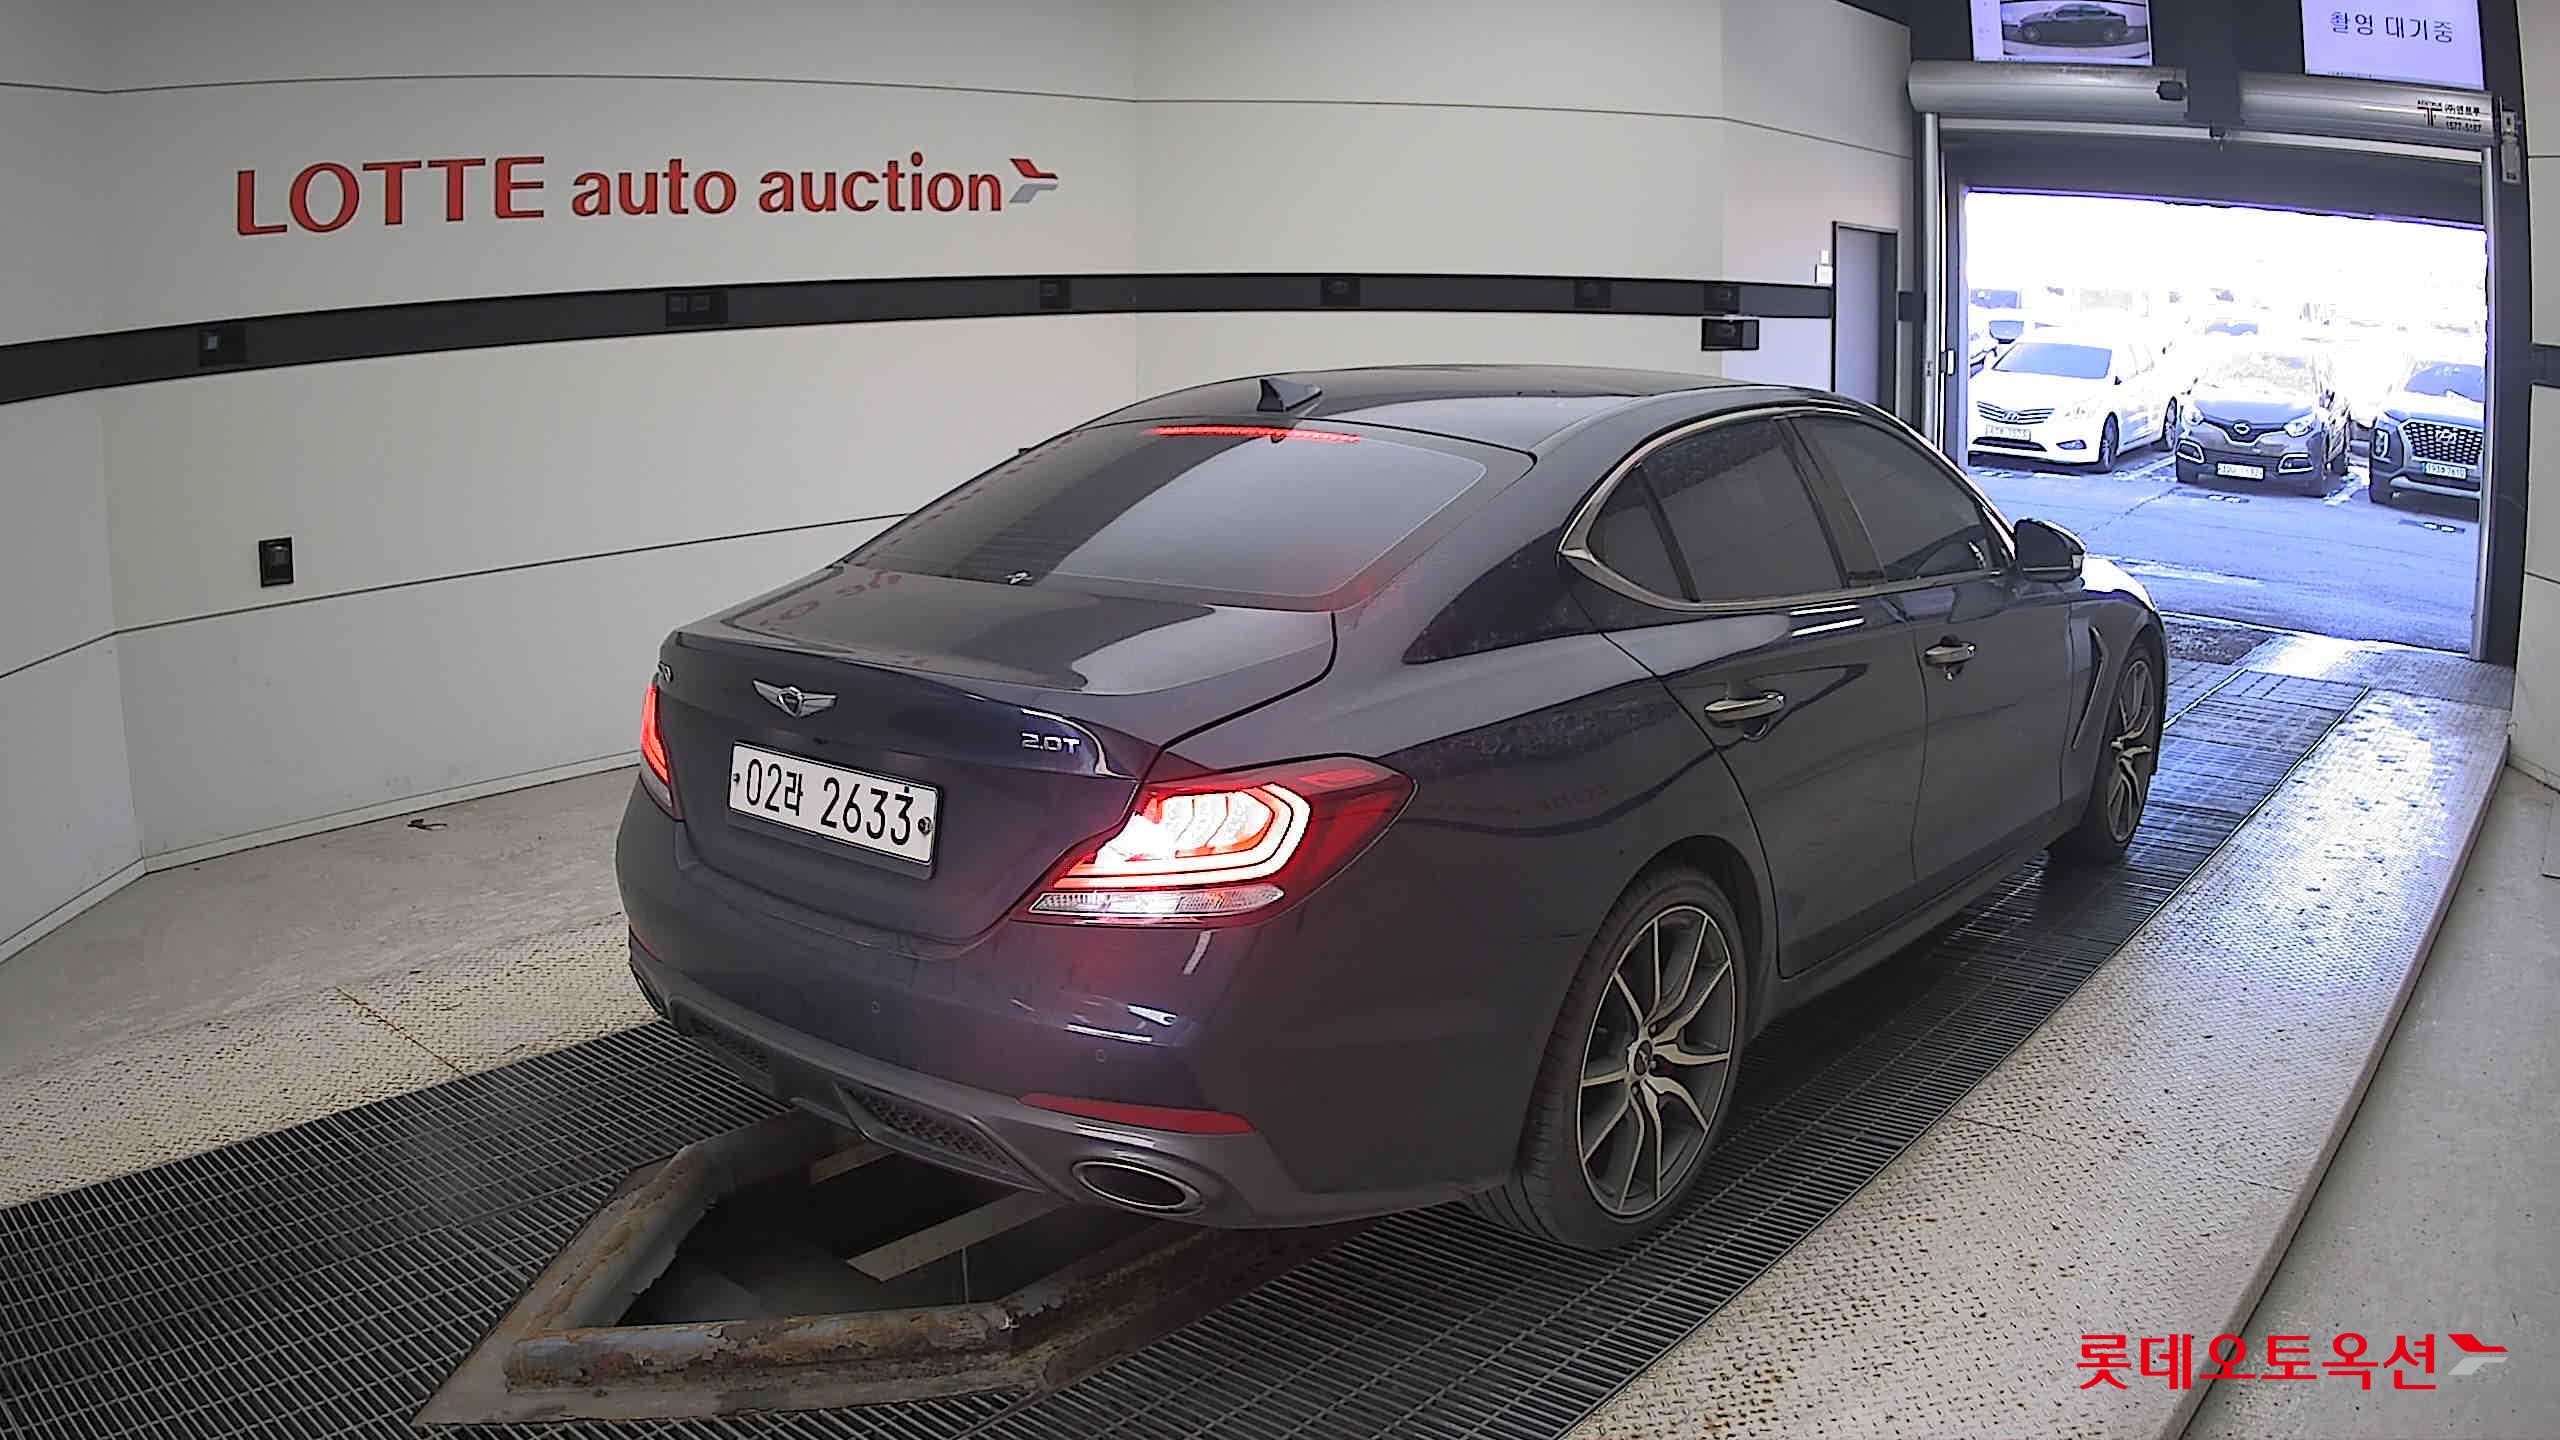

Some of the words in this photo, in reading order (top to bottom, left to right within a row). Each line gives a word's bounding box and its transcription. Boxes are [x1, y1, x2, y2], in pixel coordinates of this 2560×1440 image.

[2330, 11, 2375, 36] 촬영
[2385, 16, 2454, 43] 대기중
[236, 156, 546, 235] LOTTE
[571, 157, 738, 217] auto
[758, 151, 1005, 213] auction
[1021, 732, 1080, 754] 2.0T
[746, 758, 803, 817] 02라
[820, 777, 914, 845] 2633
